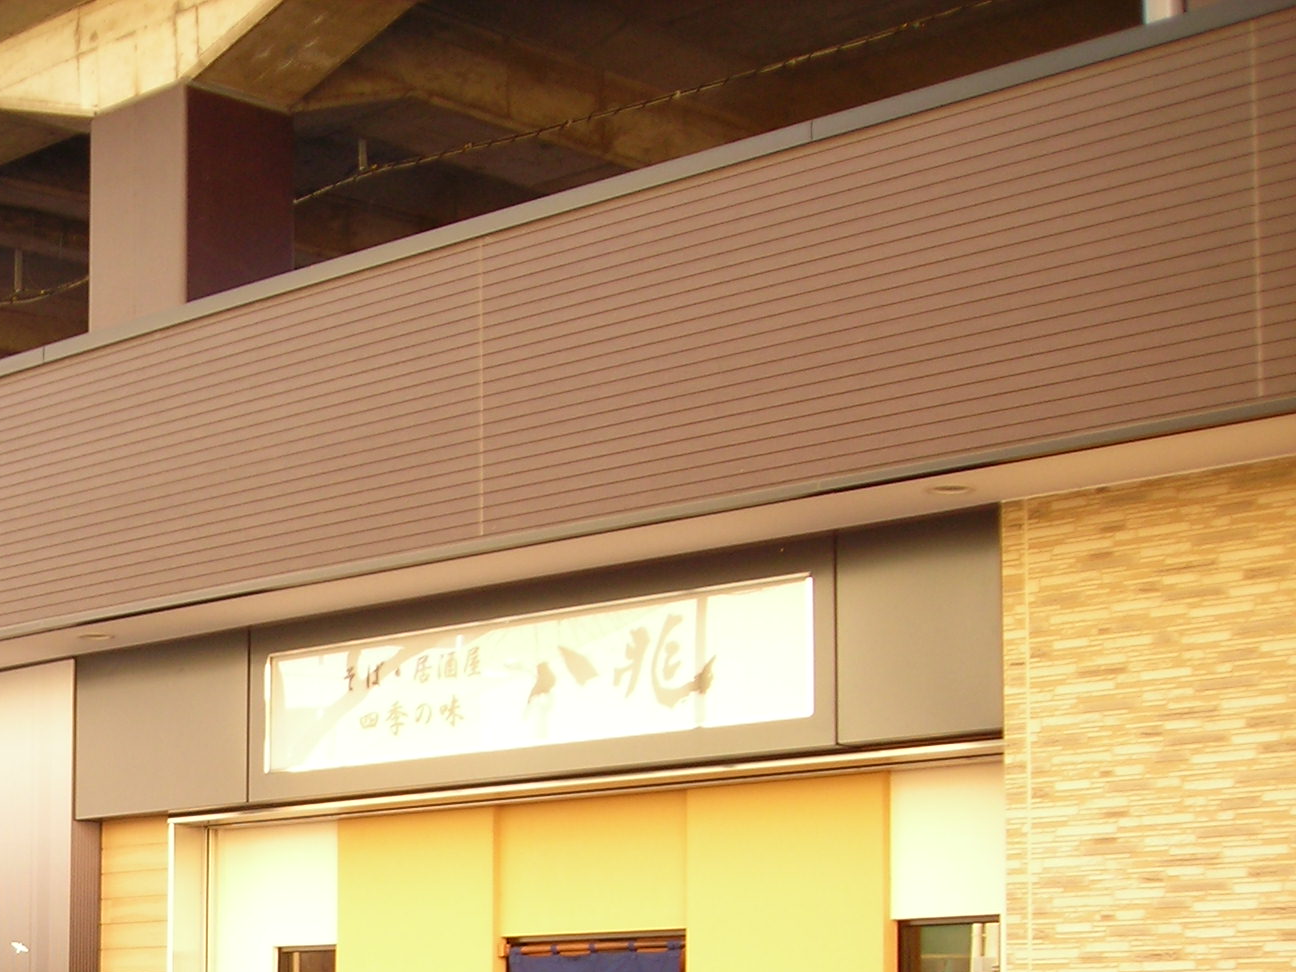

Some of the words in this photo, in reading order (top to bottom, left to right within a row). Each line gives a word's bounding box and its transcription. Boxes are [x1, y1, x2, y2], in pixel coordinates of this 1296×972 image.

[527, 613, 716, 709] 八兆
[359, 697, 465, 736] 四季の味
